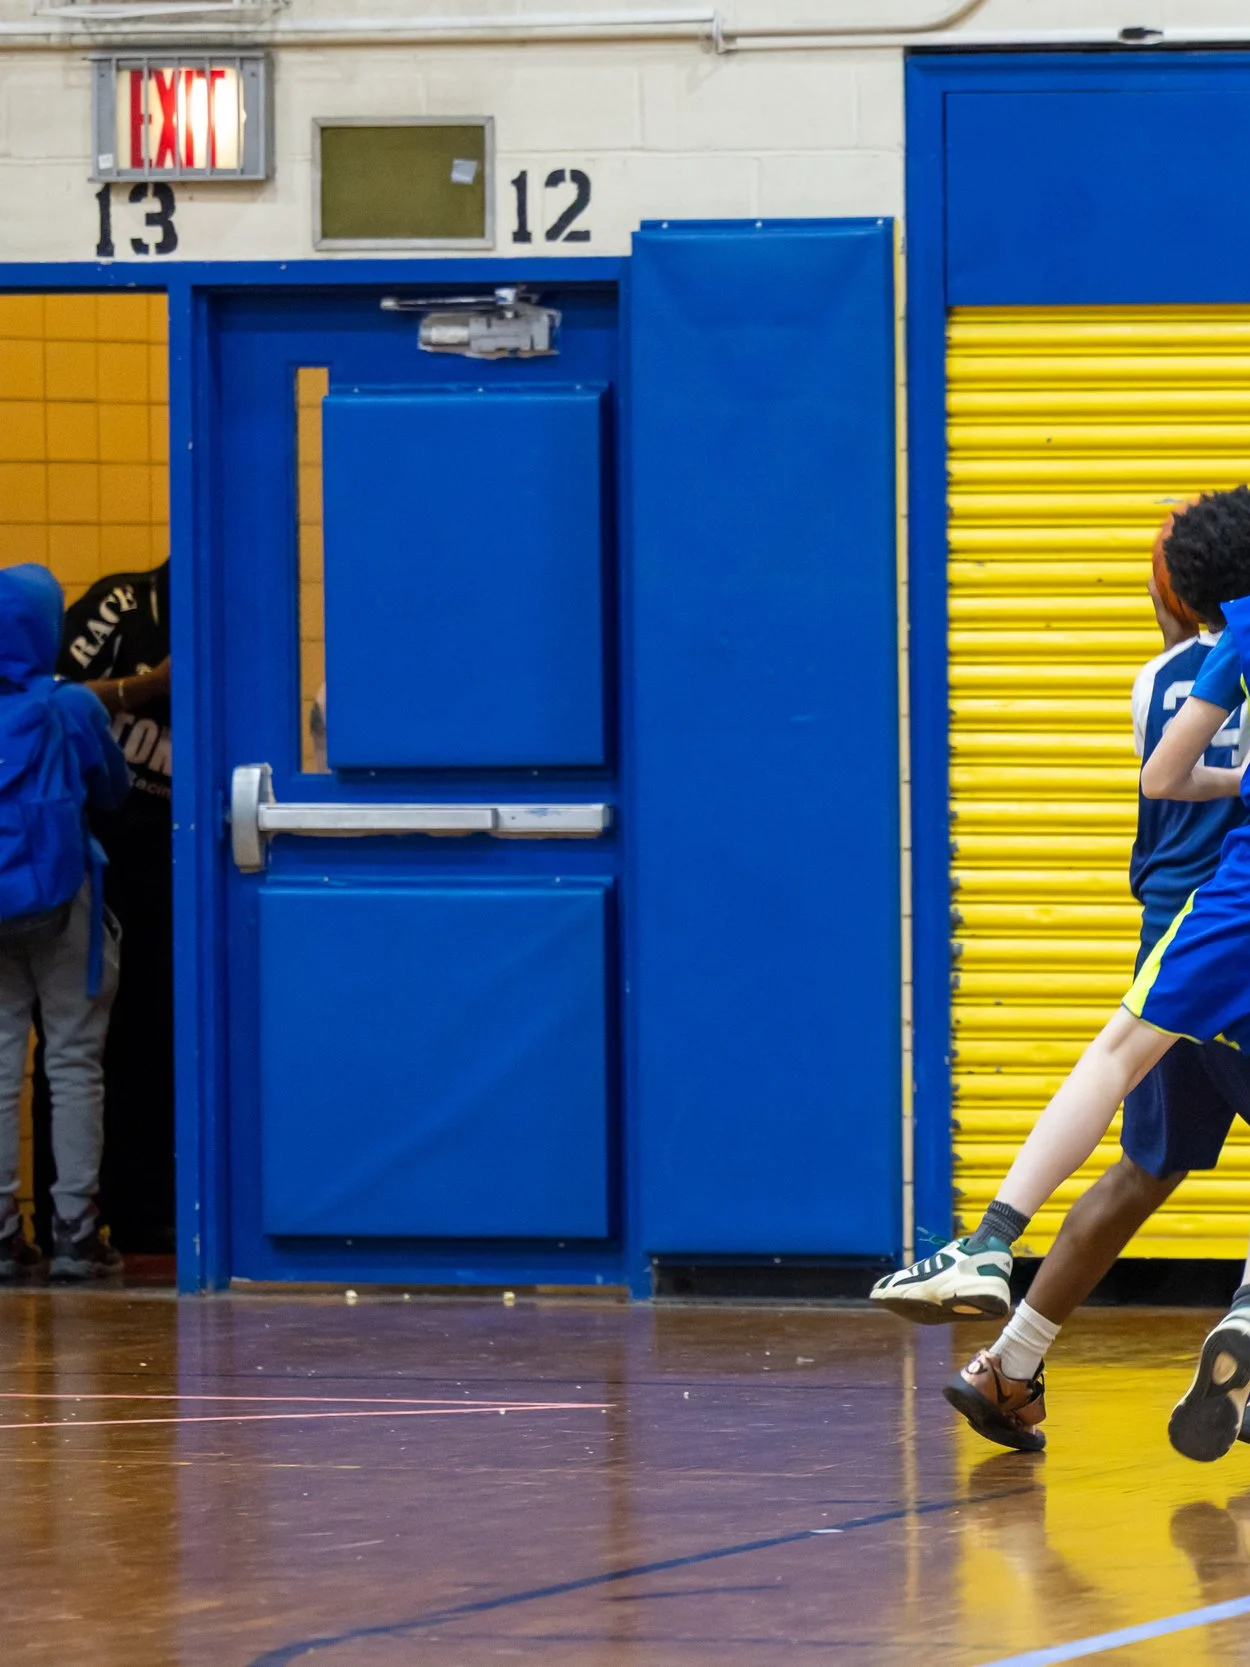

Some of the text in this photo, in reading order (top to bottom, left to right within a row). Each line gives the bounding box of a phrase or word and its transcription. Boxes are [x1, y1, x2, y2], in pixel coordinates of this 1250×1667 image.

[130, 68, 226, 169] EXIT
[96, 182, 179, 258] 13
[510, 168, 592, 244] 12
[69, 584, 138, 670] RACE
